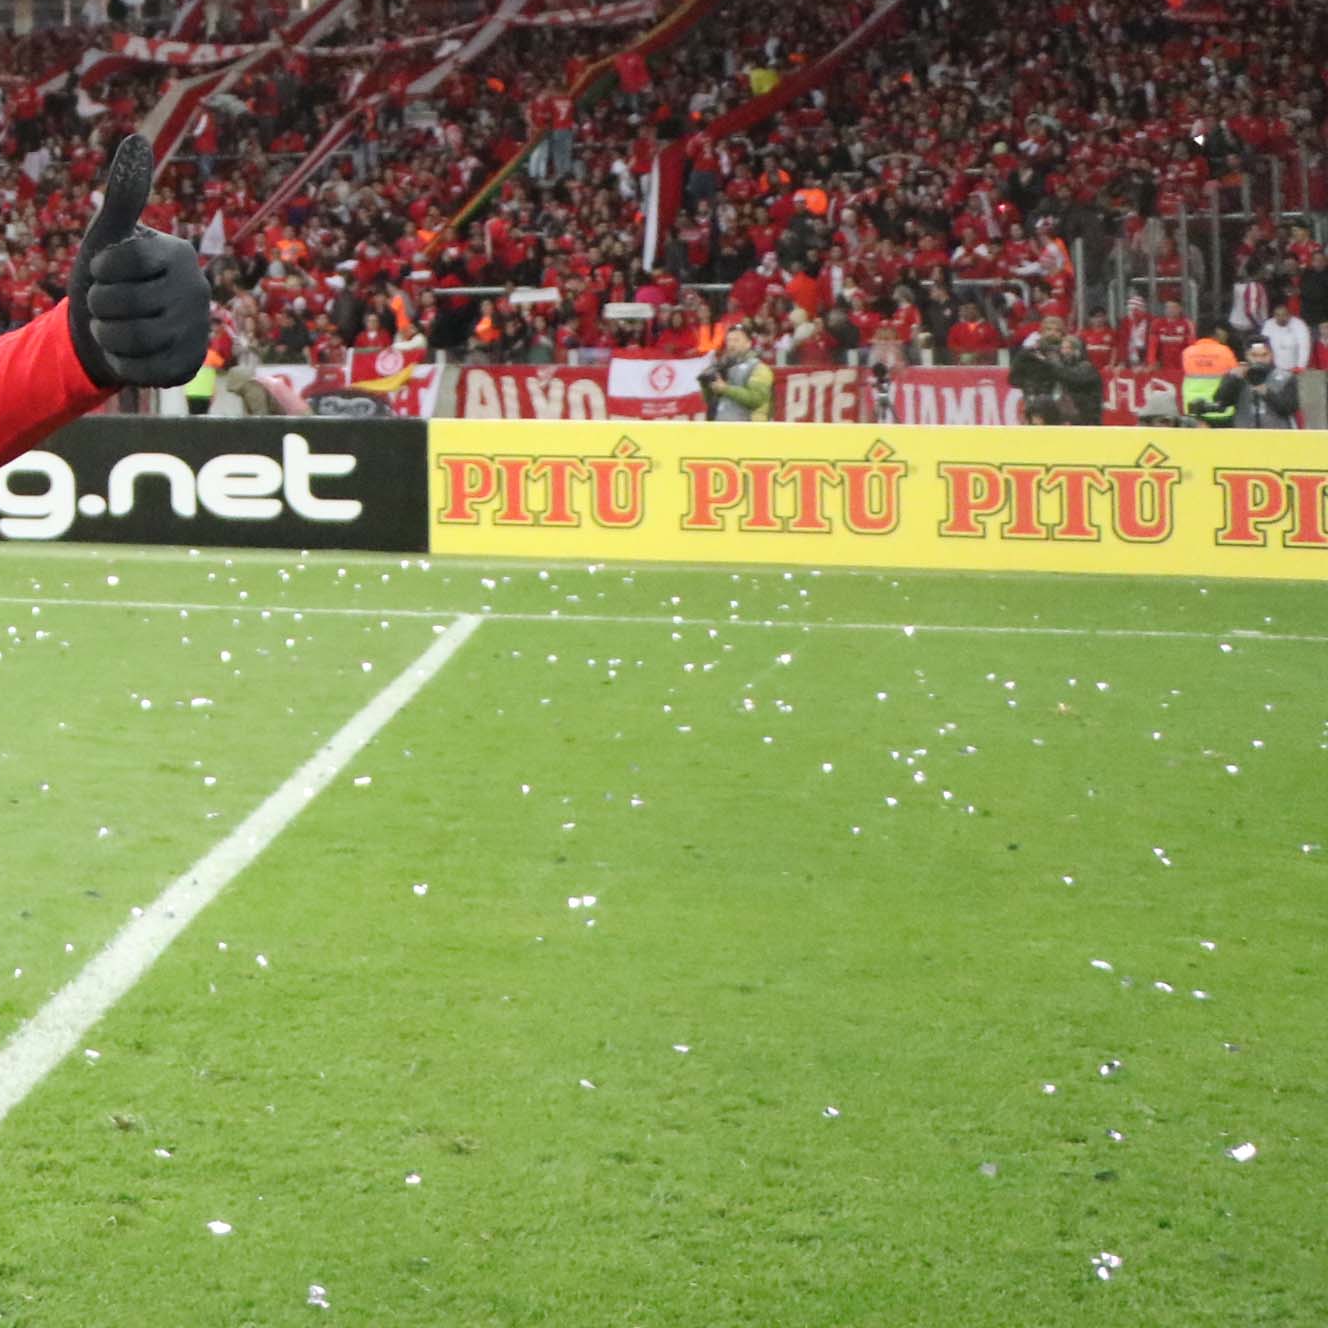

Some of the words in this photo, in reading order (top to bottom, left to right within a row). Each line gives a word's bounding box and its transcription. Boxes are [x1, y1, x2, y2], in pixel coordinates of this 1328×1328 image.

[437, 435, 651, 529] PITÚ
[680, 438, 908, 534] PITÚ
[938, 443, 1182, 544] PITÚ
